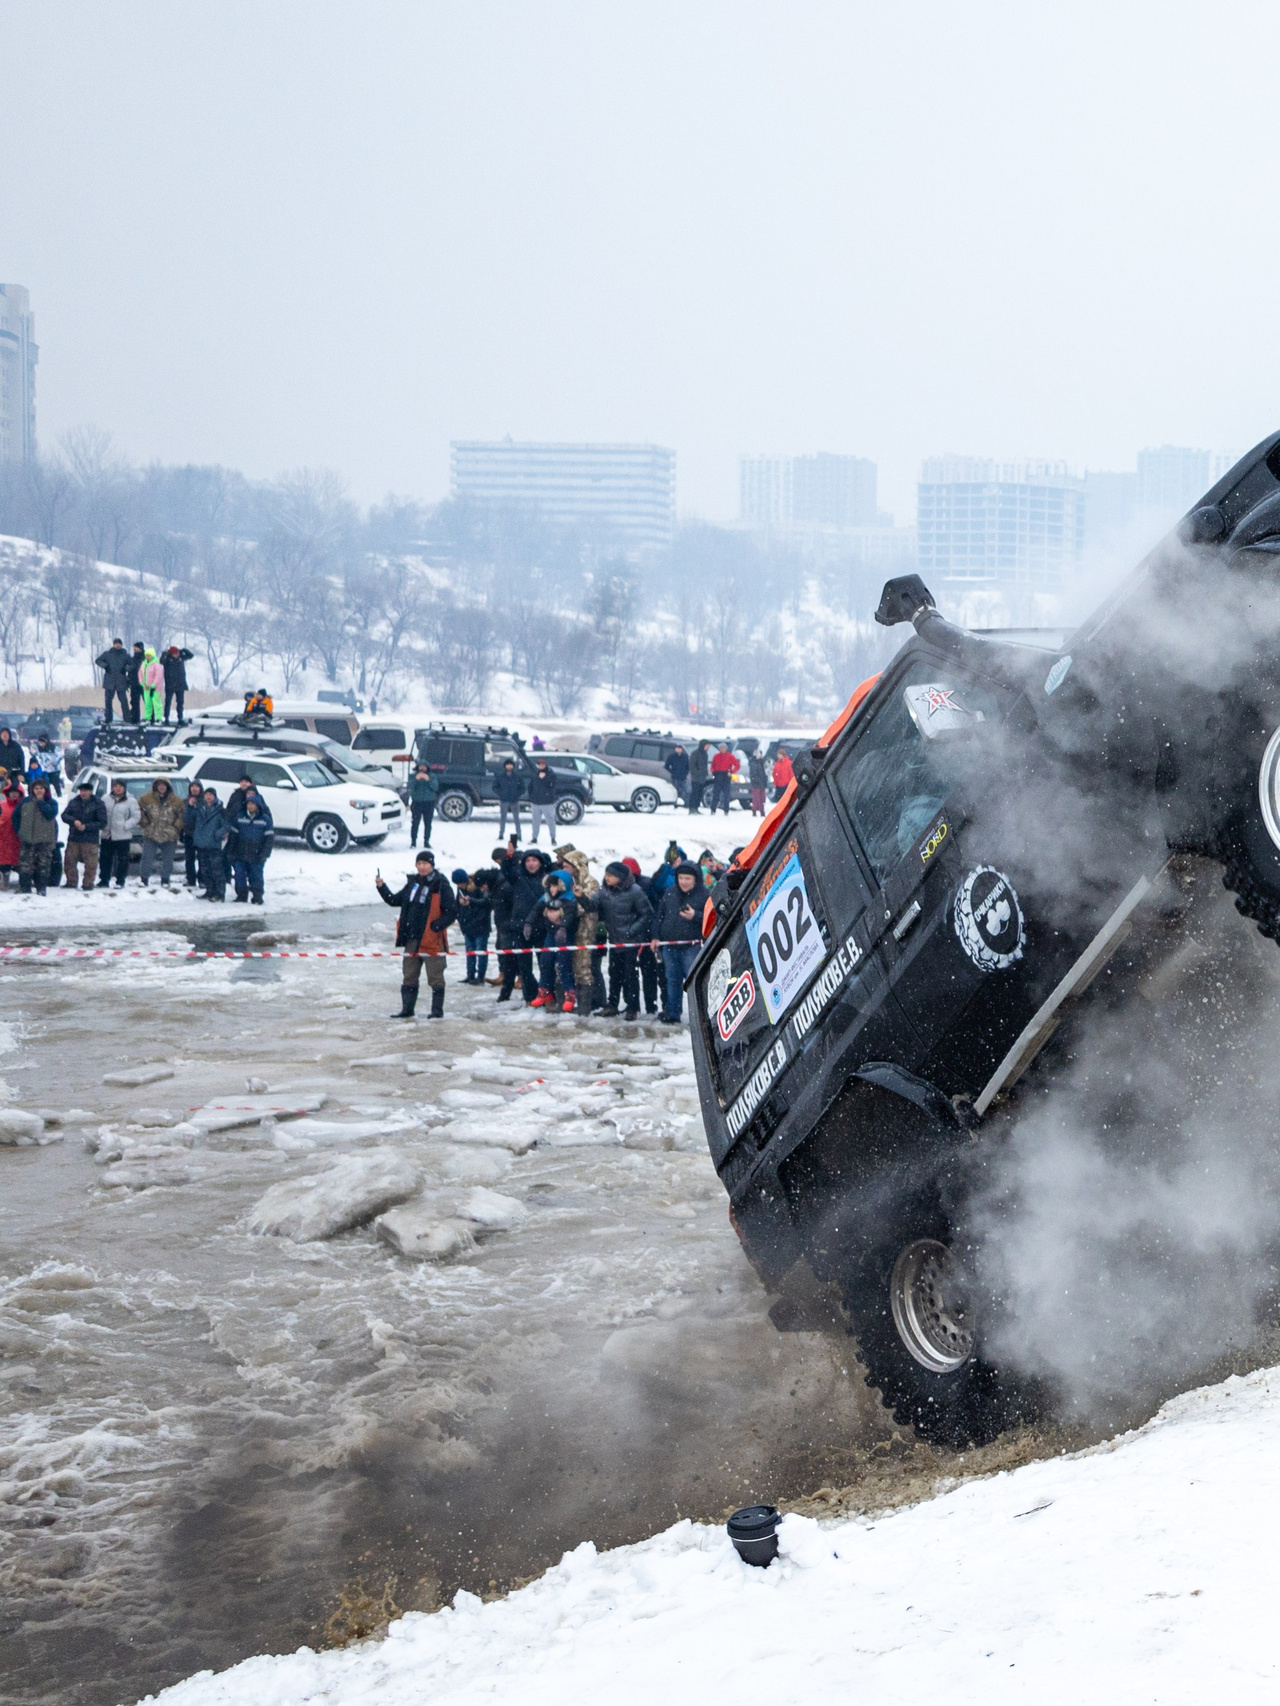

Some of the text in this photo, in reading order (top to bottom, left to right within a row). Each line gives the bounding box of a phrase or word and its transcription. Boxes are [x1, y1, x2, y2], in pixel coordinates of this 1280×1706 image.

[920, 823, 948, 864] NORD
[974, 879, 1006, 923] ОЧКАРИКИ
[757, 885, 812, 985] 002
[722, 982, 751, 1030] ARB
[793, 962, 844, 1039] ПОЛЯКОВ
[725, 1066, 771, 1139] ПОЛЯКОВ
